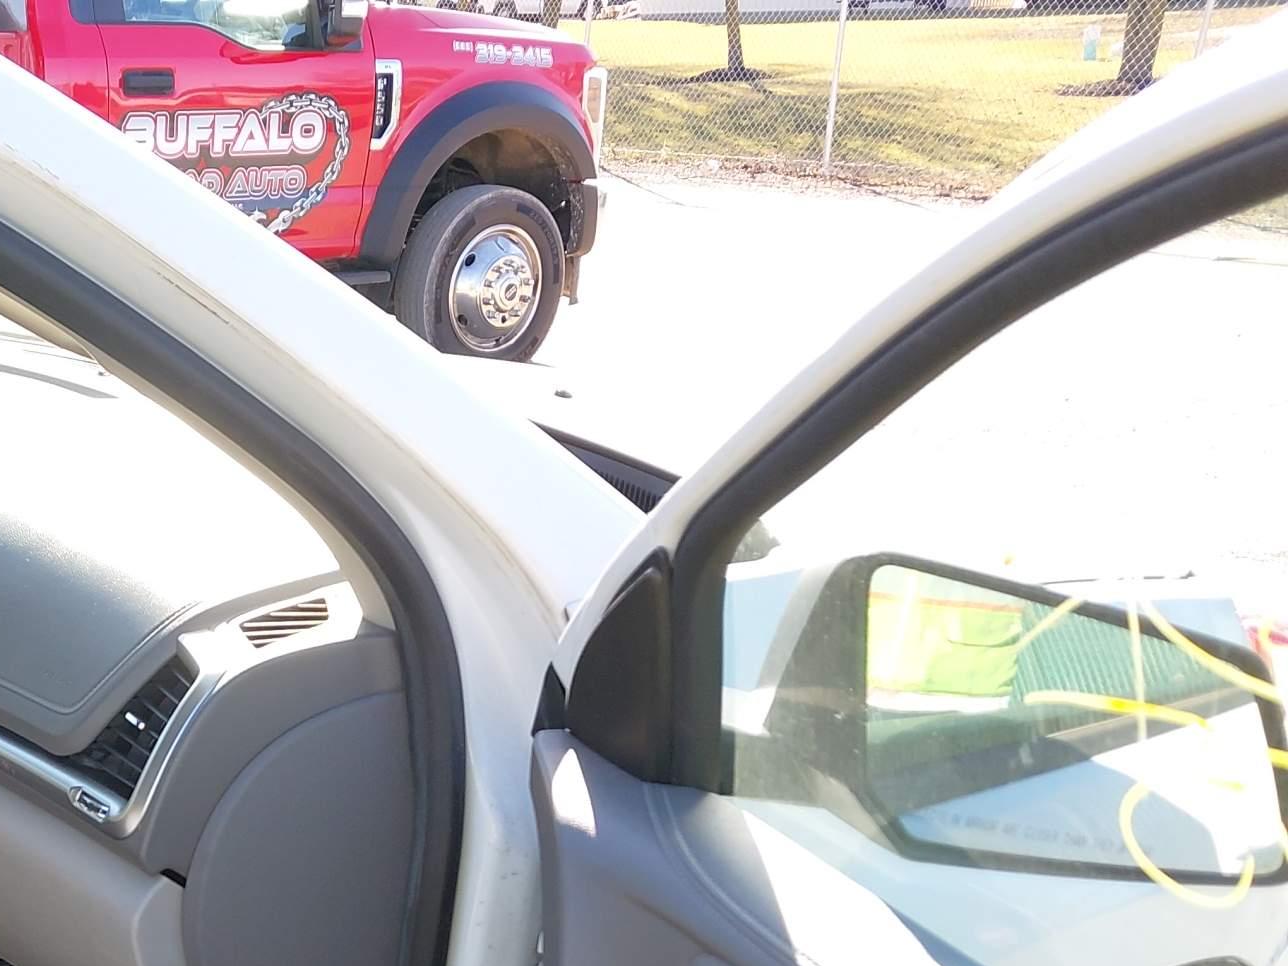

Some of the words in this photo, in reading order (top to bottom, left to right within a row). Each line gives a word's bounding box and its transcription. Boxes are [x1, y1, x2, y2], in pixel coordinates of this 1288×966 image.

[475, 42, 553, 67] 319-3415
[123, 110, 326, 158] BUFFALO
[223, 166, 307, 200] AUTO
